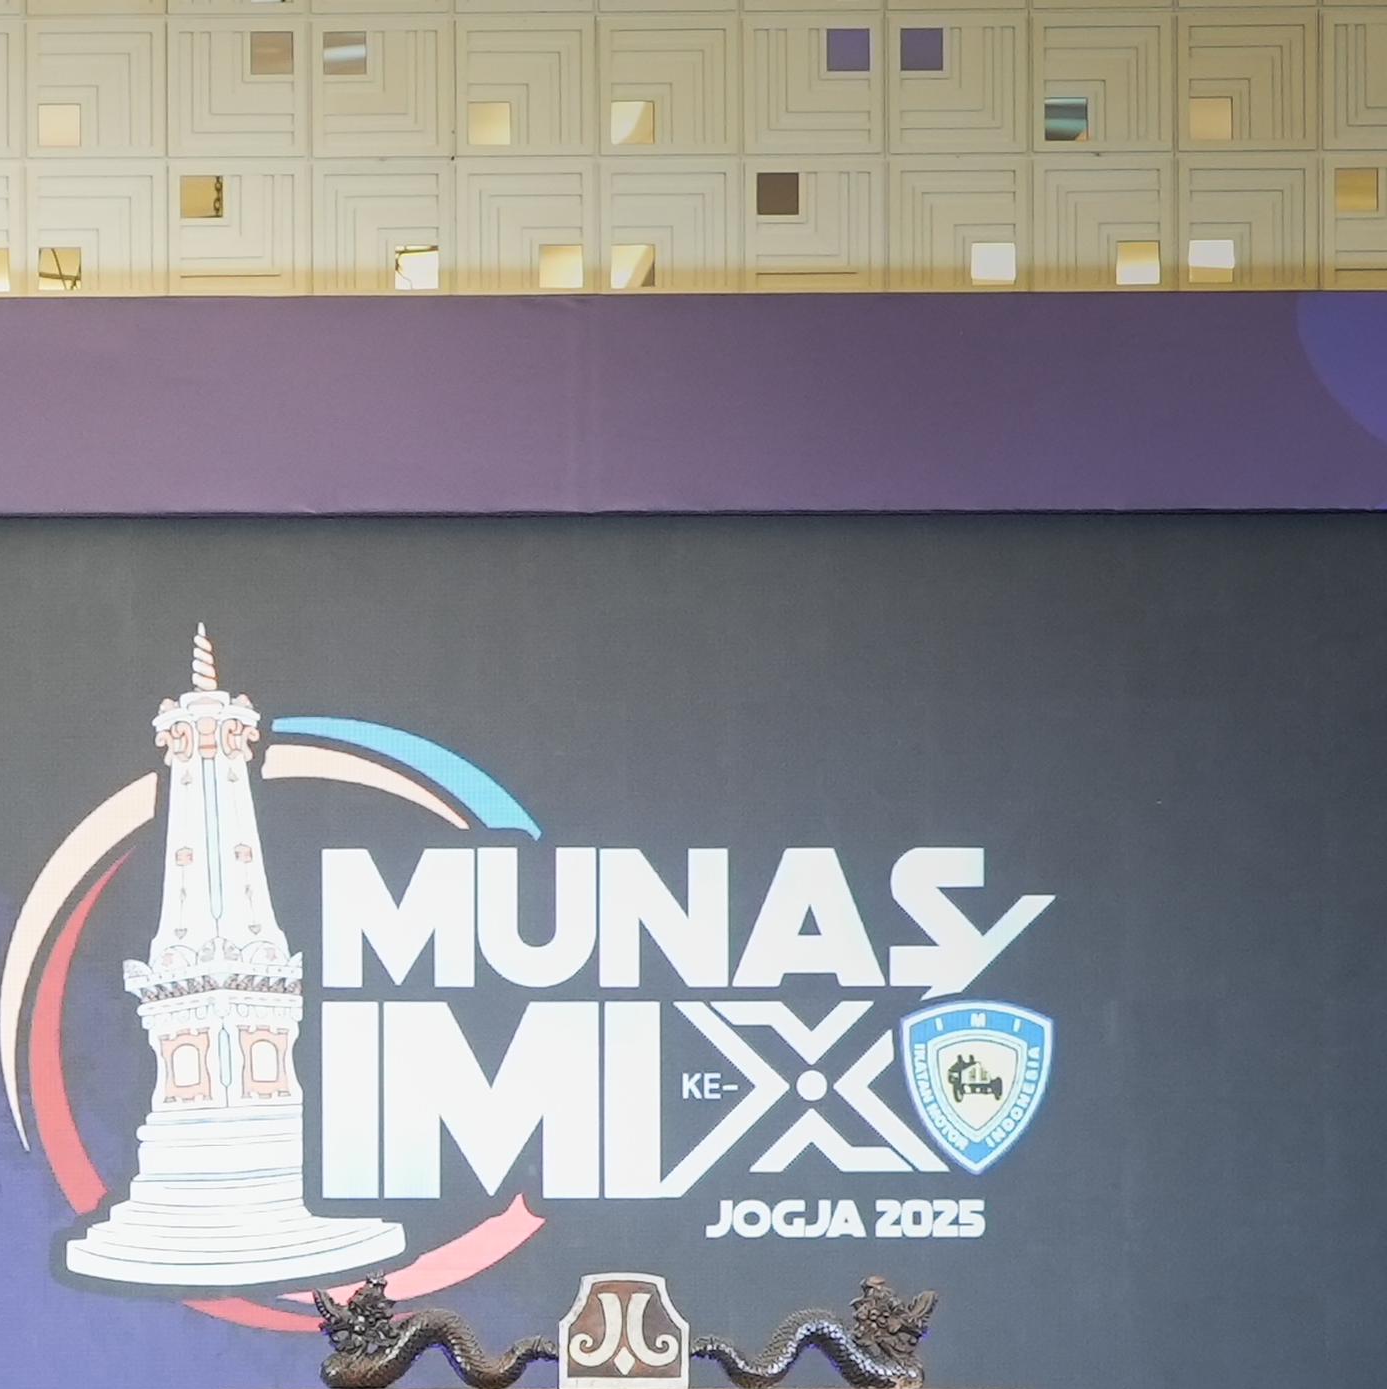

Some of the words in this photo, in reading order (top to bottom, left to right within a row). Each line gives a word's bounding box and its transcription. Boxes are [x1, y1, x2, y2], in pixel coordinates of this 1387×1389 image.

[322, 847, 1056, 1000] MUNAS
[322, 1001, 677, 1199] IMI
[682, 1073, 738, 1100] KE-
[913, 1043, 934, 1103] IKATAN
[985, 1047, 1041, 1148] INDONESIA
[927, 1104, 969, 1151] MOTOR
[706, 1200, 867, 1239] JOGJA
[875, 1200, 986, 1239] 2025
